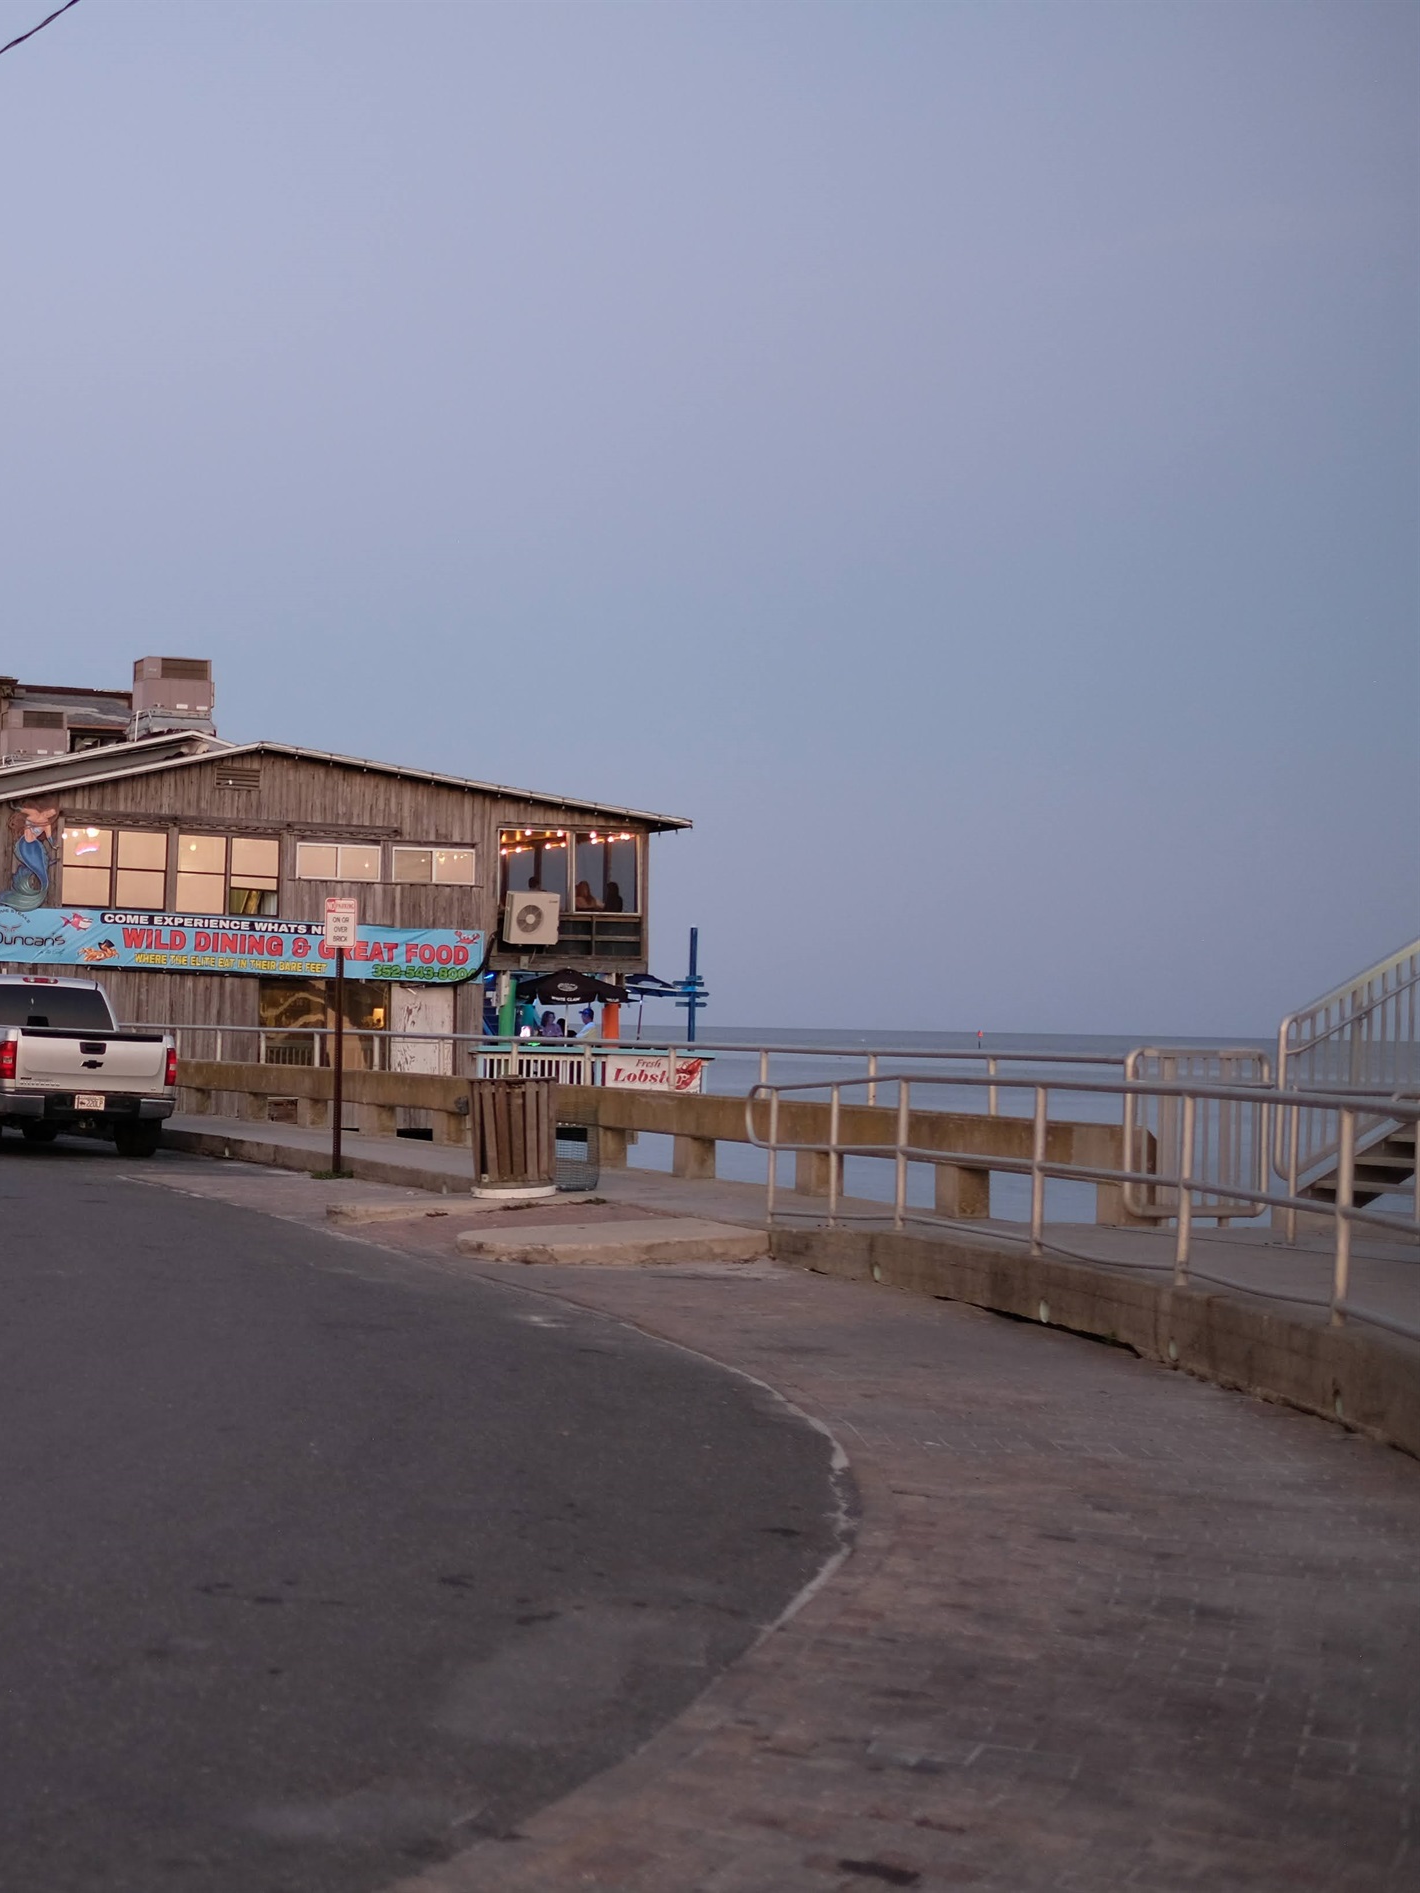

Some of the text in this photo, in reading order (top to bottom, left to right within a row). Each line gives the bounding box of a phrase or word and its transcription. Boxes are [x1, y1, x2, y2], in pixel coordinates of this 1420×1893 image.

[104, 913, 149, 925] COME
[154, 915, 250, 931] EXPERIENCE
[254, 922, 307, 934] WHATS
[122, 928, 186, 950] WILD
[194, 931, 283, 957] DINING
[292, 937, 311, 958] &
[404, 944, 469, 966] FOOD
[134, 953, 328, 973] WHERE THE ELITE EAT IN THEIR BARE FEET
[636, 1058, 662, 1068] Fresh
